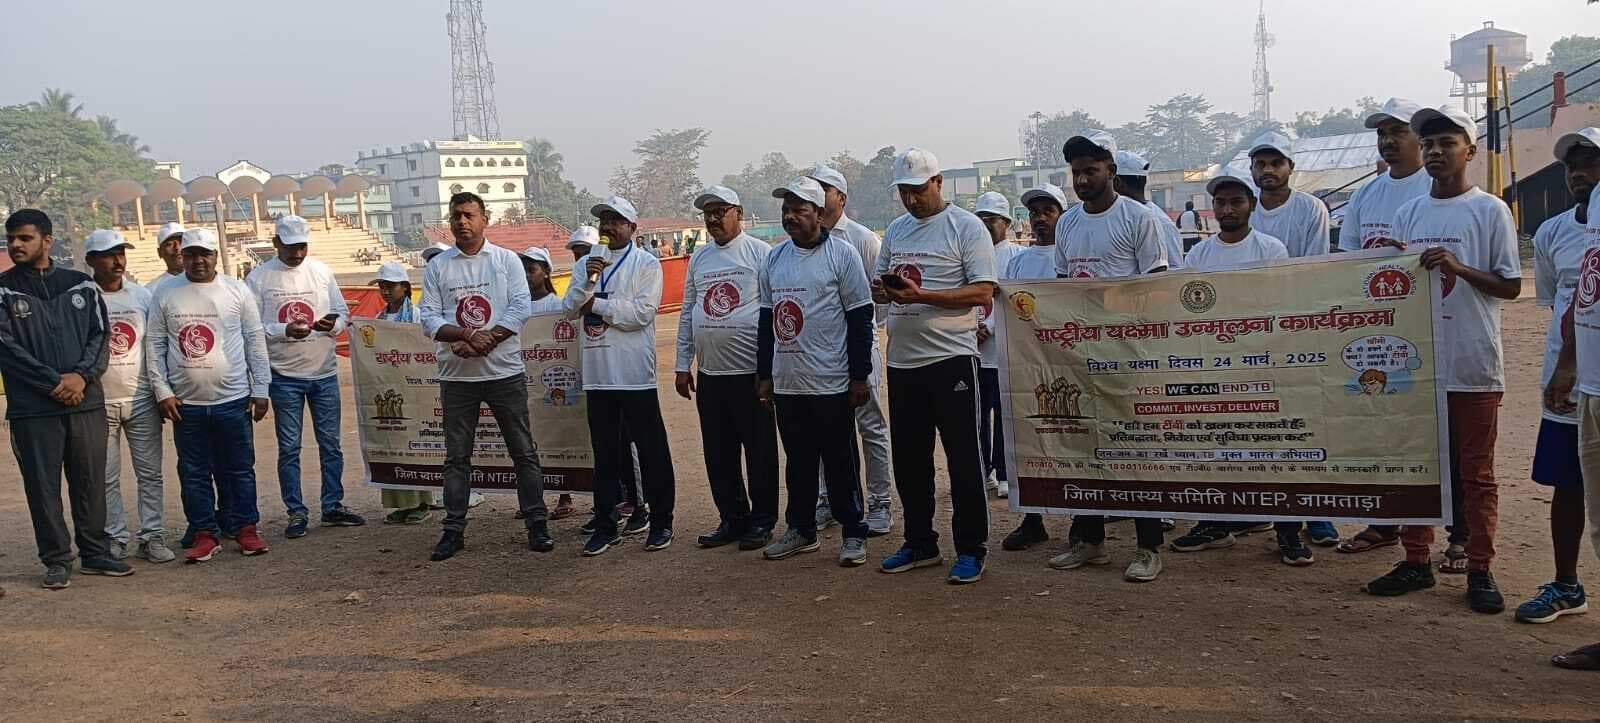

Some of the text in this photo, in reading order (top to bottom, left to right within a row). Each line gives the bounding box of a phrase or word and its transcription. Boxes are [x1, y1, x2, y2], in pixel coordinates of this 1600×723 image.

[1035, 305, 1396, 350] राष्ट्रीय यक्ष्मा उन्मूलन कार्यक्रम
[376, 349, 411, 368] राष्ट्रीय
[1087, 358, 1120, 372] विश्व
[1128, 359, 1159, 370] यक्ष्मा
[1168, 355, 1203, 368] दिवस
[1213, 357, 1232, 367] 24
[1286, 352, 1327, 364] 2025
[1136, 383, 1270, 396] YES! WE CAN END TB
[1138, 404, 1182, 414] COMMIT,
[1228, 402, 1275, 412] DELIVER
[1186, 420, 1202, 430] को
[1234, 421, 1254, 430] कर
[1256, 418, 1288, 429] सकते
[1215, 431, 1248, 445] सुविधा
[1252, 432, 1282, 442] प्रदान
[1096, 450, 1130, 458] जन-जन
[1136, 450, 1148, 458] का
[1222, 450, 1242, 460] मुक्त
[1249, 450, 1274, 460] भारत
[1280, 450, 1320, 460] अभियान
[394, 466, 418, 480] जिला
[1063, 484, 1382, 512] जिला स्वास्थ्य समिति NTEP, जामताड़ा
